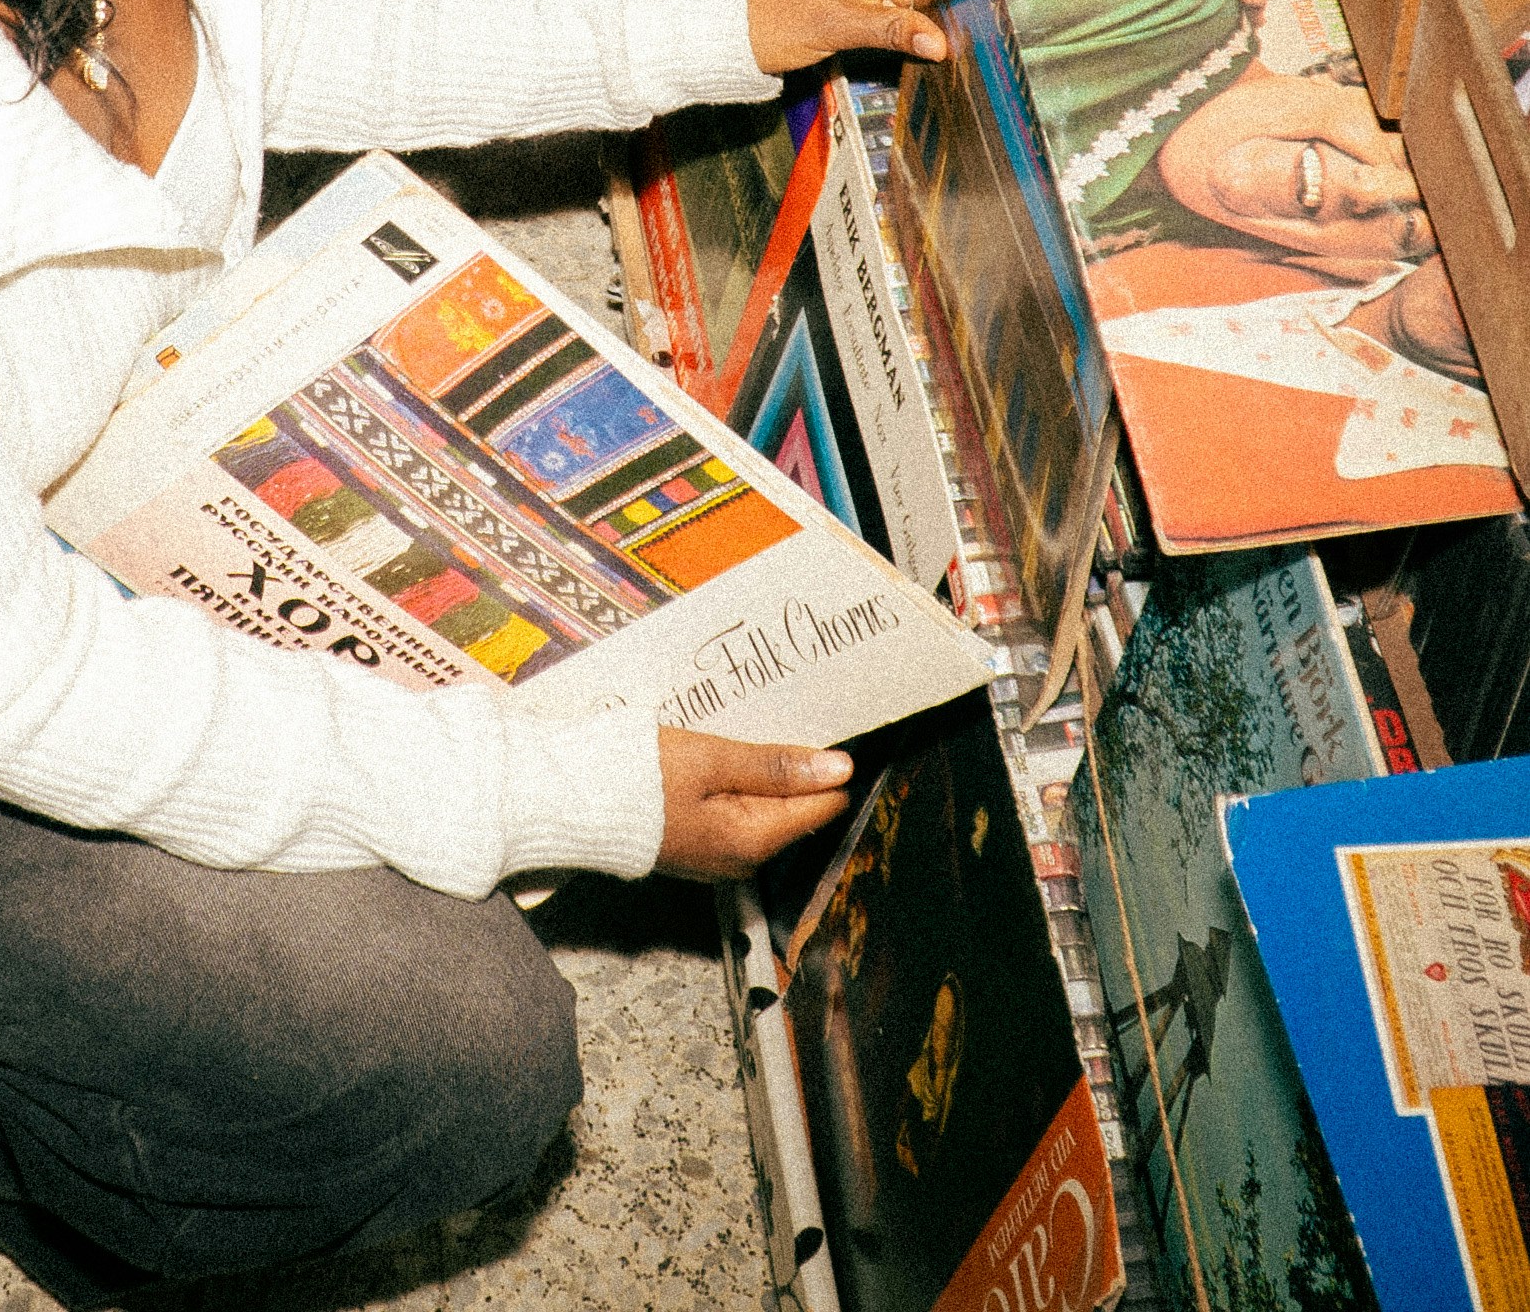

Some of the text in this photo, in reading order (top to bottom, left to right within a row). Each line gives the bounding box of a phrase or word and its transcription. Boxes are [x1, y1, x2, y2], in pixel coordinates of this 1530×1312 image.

[839, 180, 906, 412] ERIK BERGMAN
[226, 559, 382, 669] ХОР
[693, 620, 796, 700] Folk
[784, 594, 900, 664] Chorus
[1294, 621, 1345, 765] Björk
[1431, 859, 1470, 911] OCH
[1448, 923, 1490, 988] TROS
[1482, 937, 1515, 971] RO
[987, 1126, 1077, 1269] VID BETLEHEM
